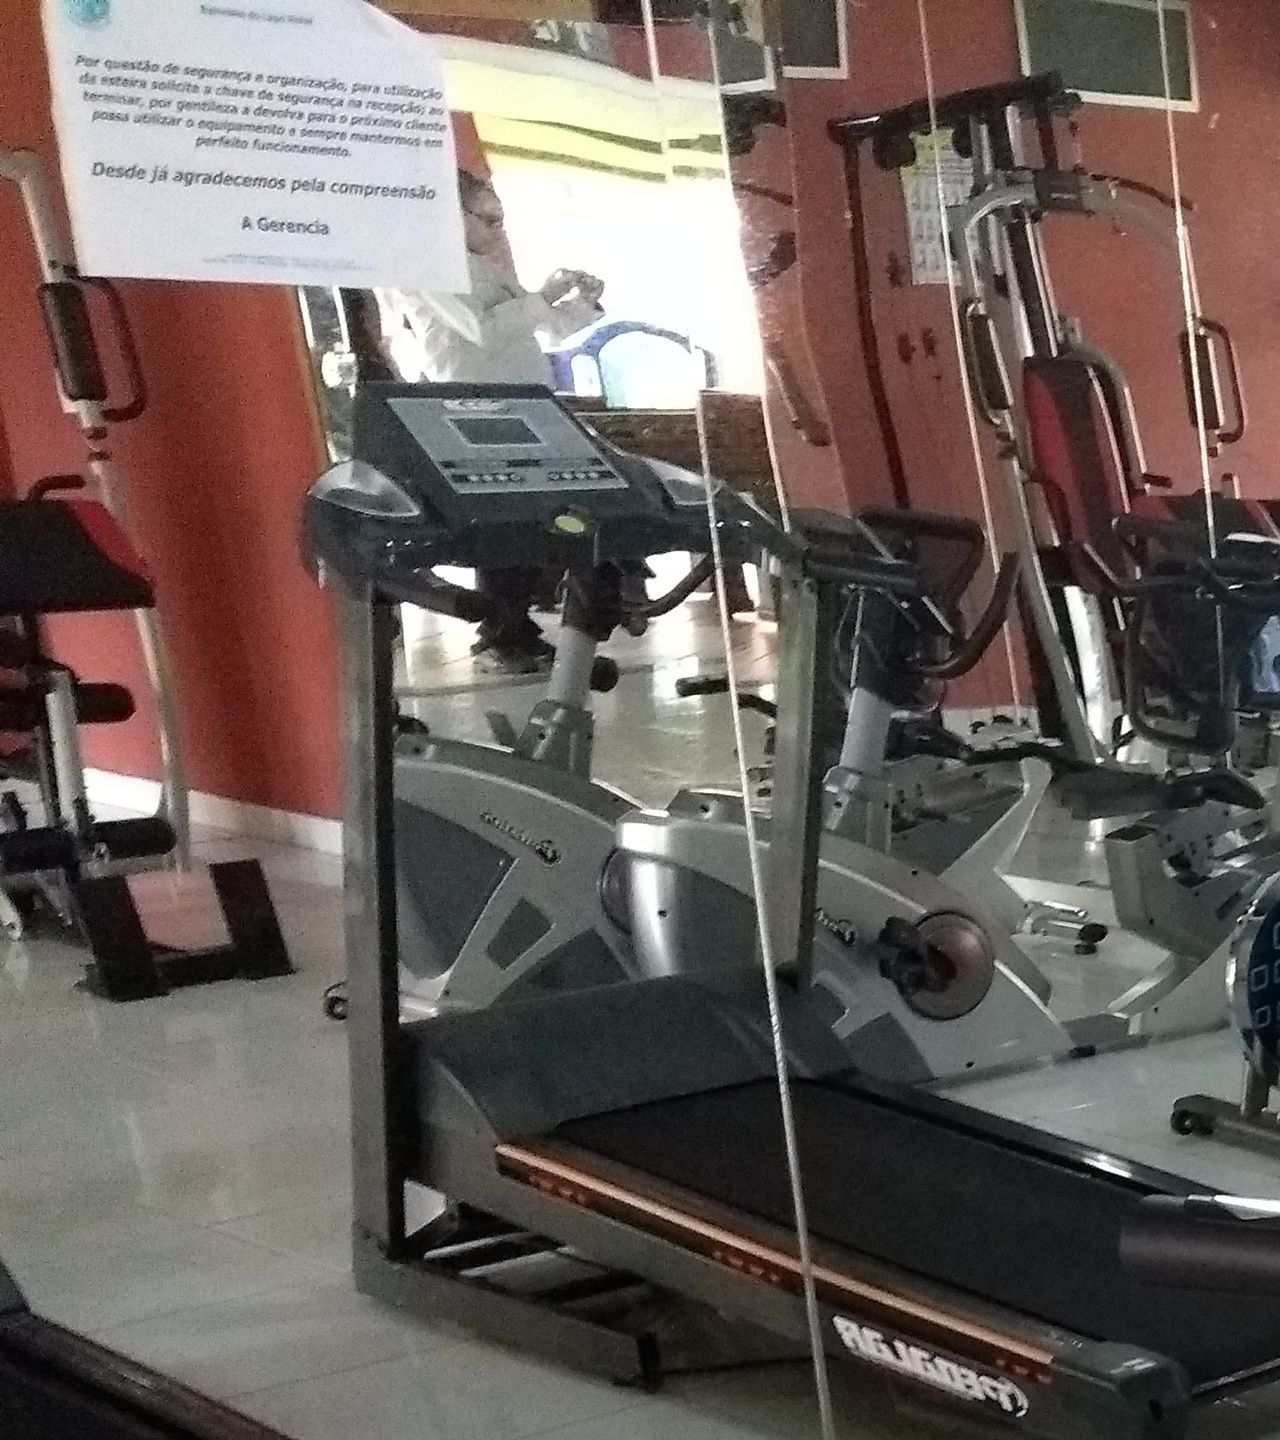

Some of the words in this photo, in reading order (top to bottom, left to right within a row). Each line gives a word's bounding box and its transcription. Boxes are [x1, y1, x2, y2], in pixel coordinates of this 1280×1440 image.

[75, 55, 100, 67] Por
[104, 59, 159, 73] questão
[163, 63, 179, 74] de
[183, 66, 252, 83] segurança
[266, 75, 347, 93] organização,
[350, 82, 380, 95] para
[384, 84, 442, 101] utilização
[101, 75, 147, 90] esteira
[215, 86, 254, 98] chave
[277, 92, 343, 109] segurança
[428, 107, 443, 117] ao
[92, 110, 129, 123] possa
[133, 113, 183, 127] utilizar
[197, 119, 285, 136] equipamento
[299, 128, 347, 142] sempre
[424, 138, 443, 148] em
[149, 99, 172, 111] por
[176, 100, 238, 115] gentileza
[253, 105, 304, 120] devolva
[307, 111, 336, 124] para
[350, 114, 401, 130] próximo
[405, 119, 447, 133] cliente
[195, 135, 248, 150] perfeito
[91, 160, 146, 181] Desde
[150, 166, 169, 184] já
[172, 168, 286, 193] agradecemos
[290, 178, 325, 195] pela
[329, 179, 436, 201] compreensão
[241, 215, 252, 231] A
